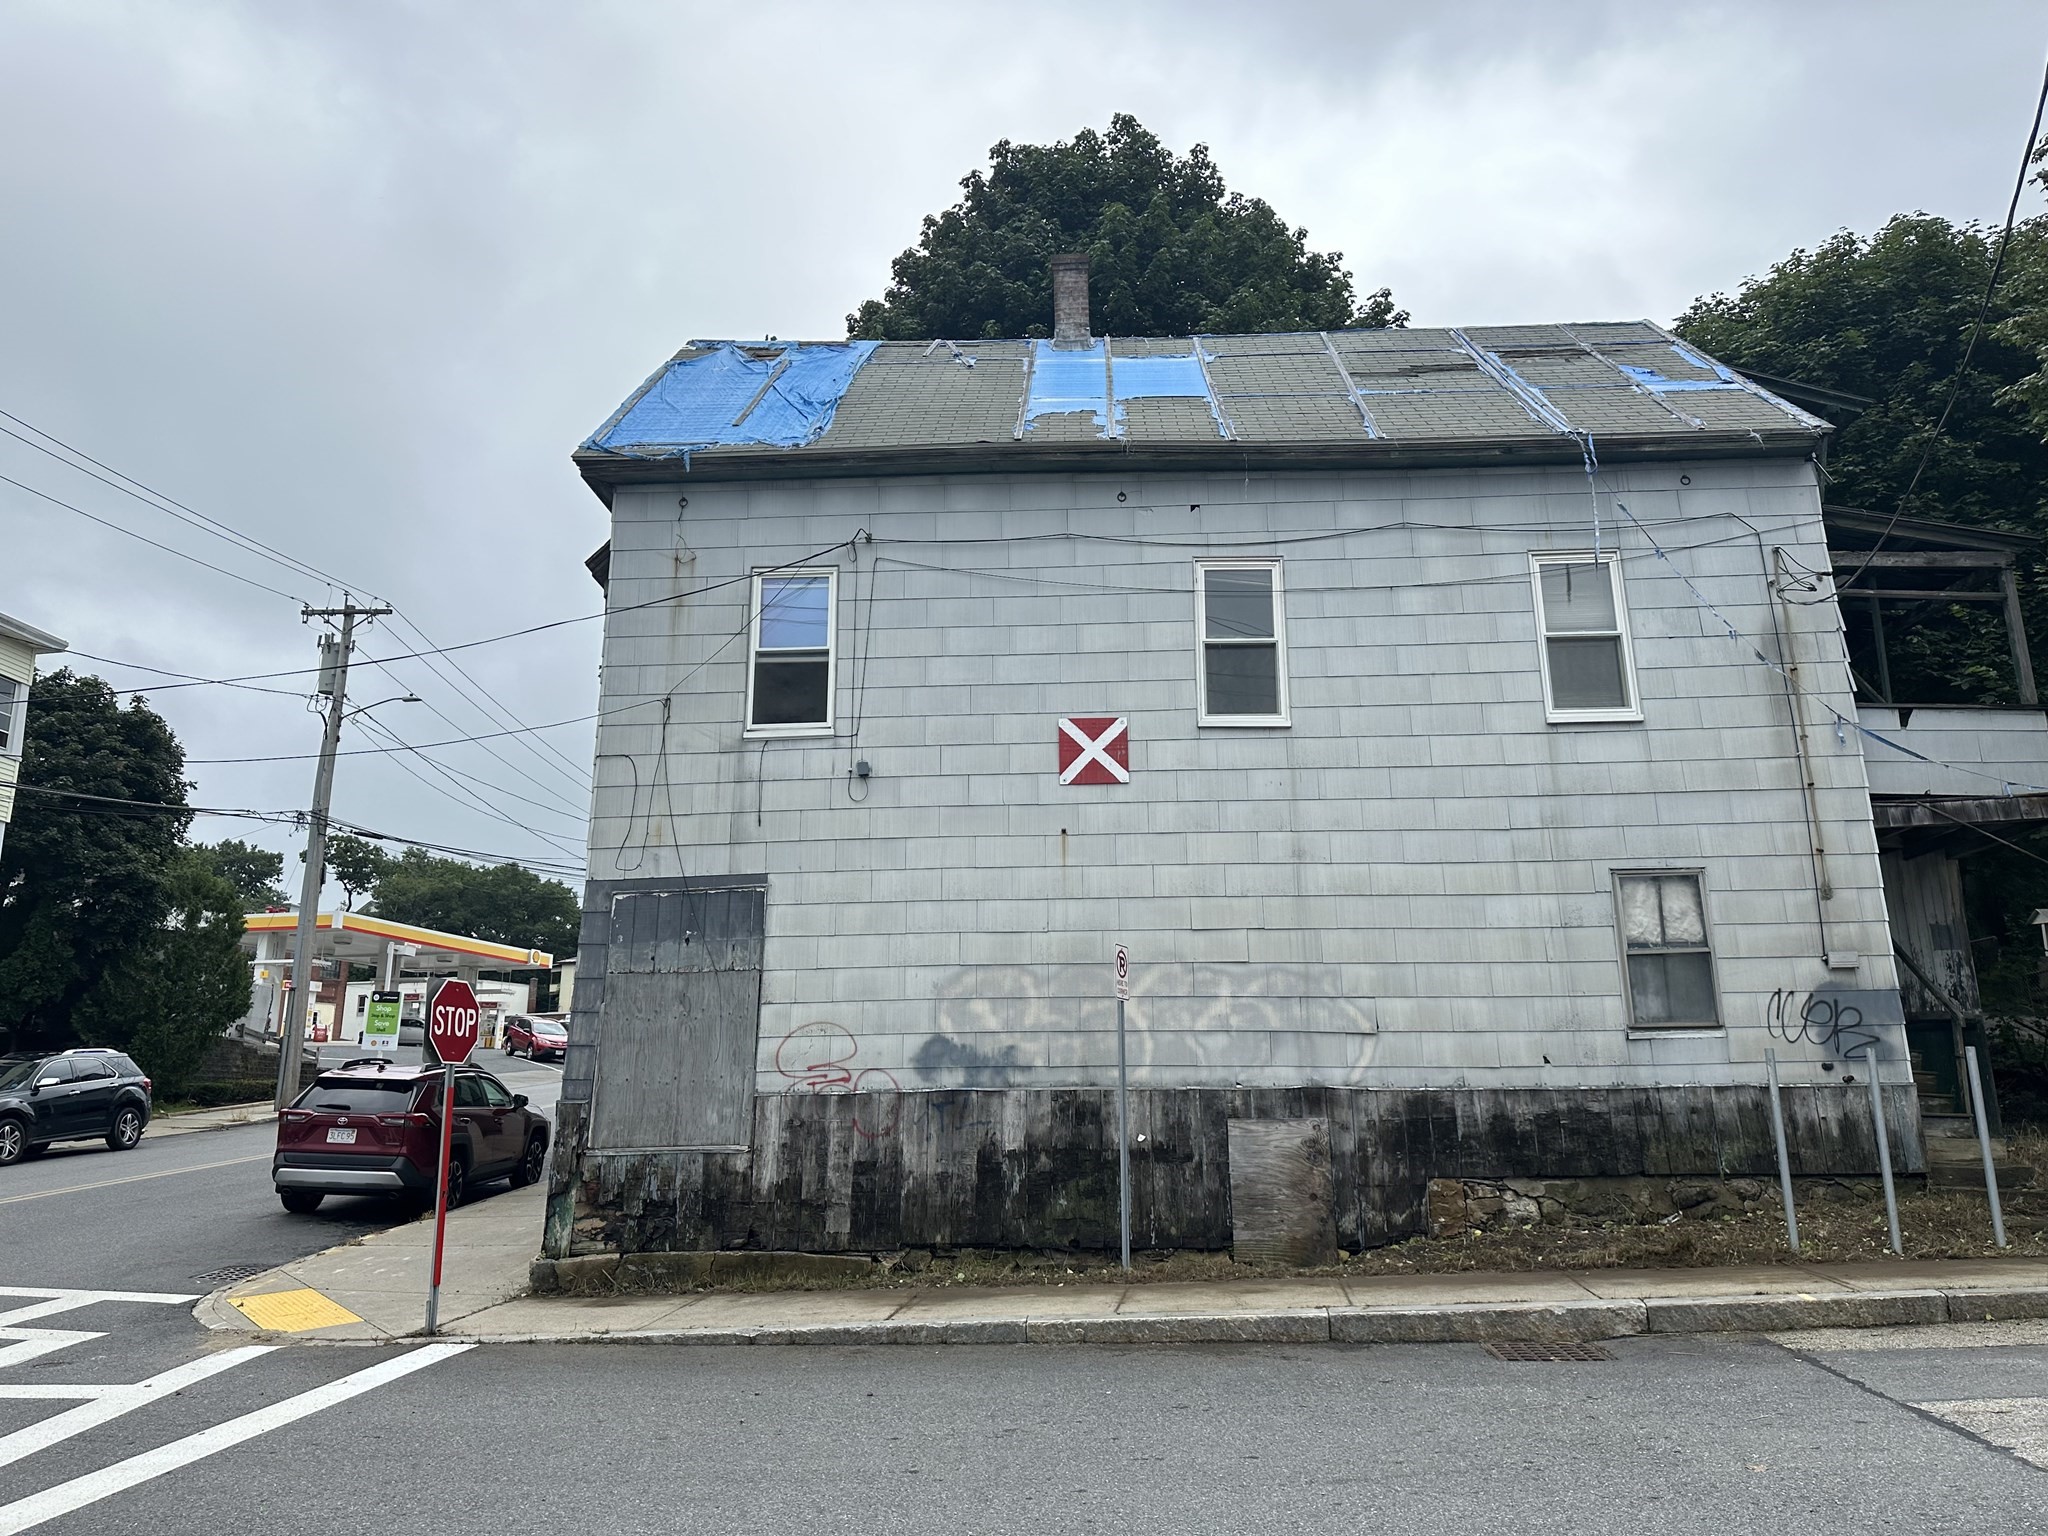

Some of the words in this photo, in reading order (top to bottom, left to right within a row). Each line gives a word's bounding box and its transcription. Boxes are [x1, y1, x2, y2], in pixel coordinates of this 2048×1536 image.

[375, 1004, 392, 1013] Shop
[374, 1019, 390, 1027] Save
[434, 1005, 477, 1038] STOP
